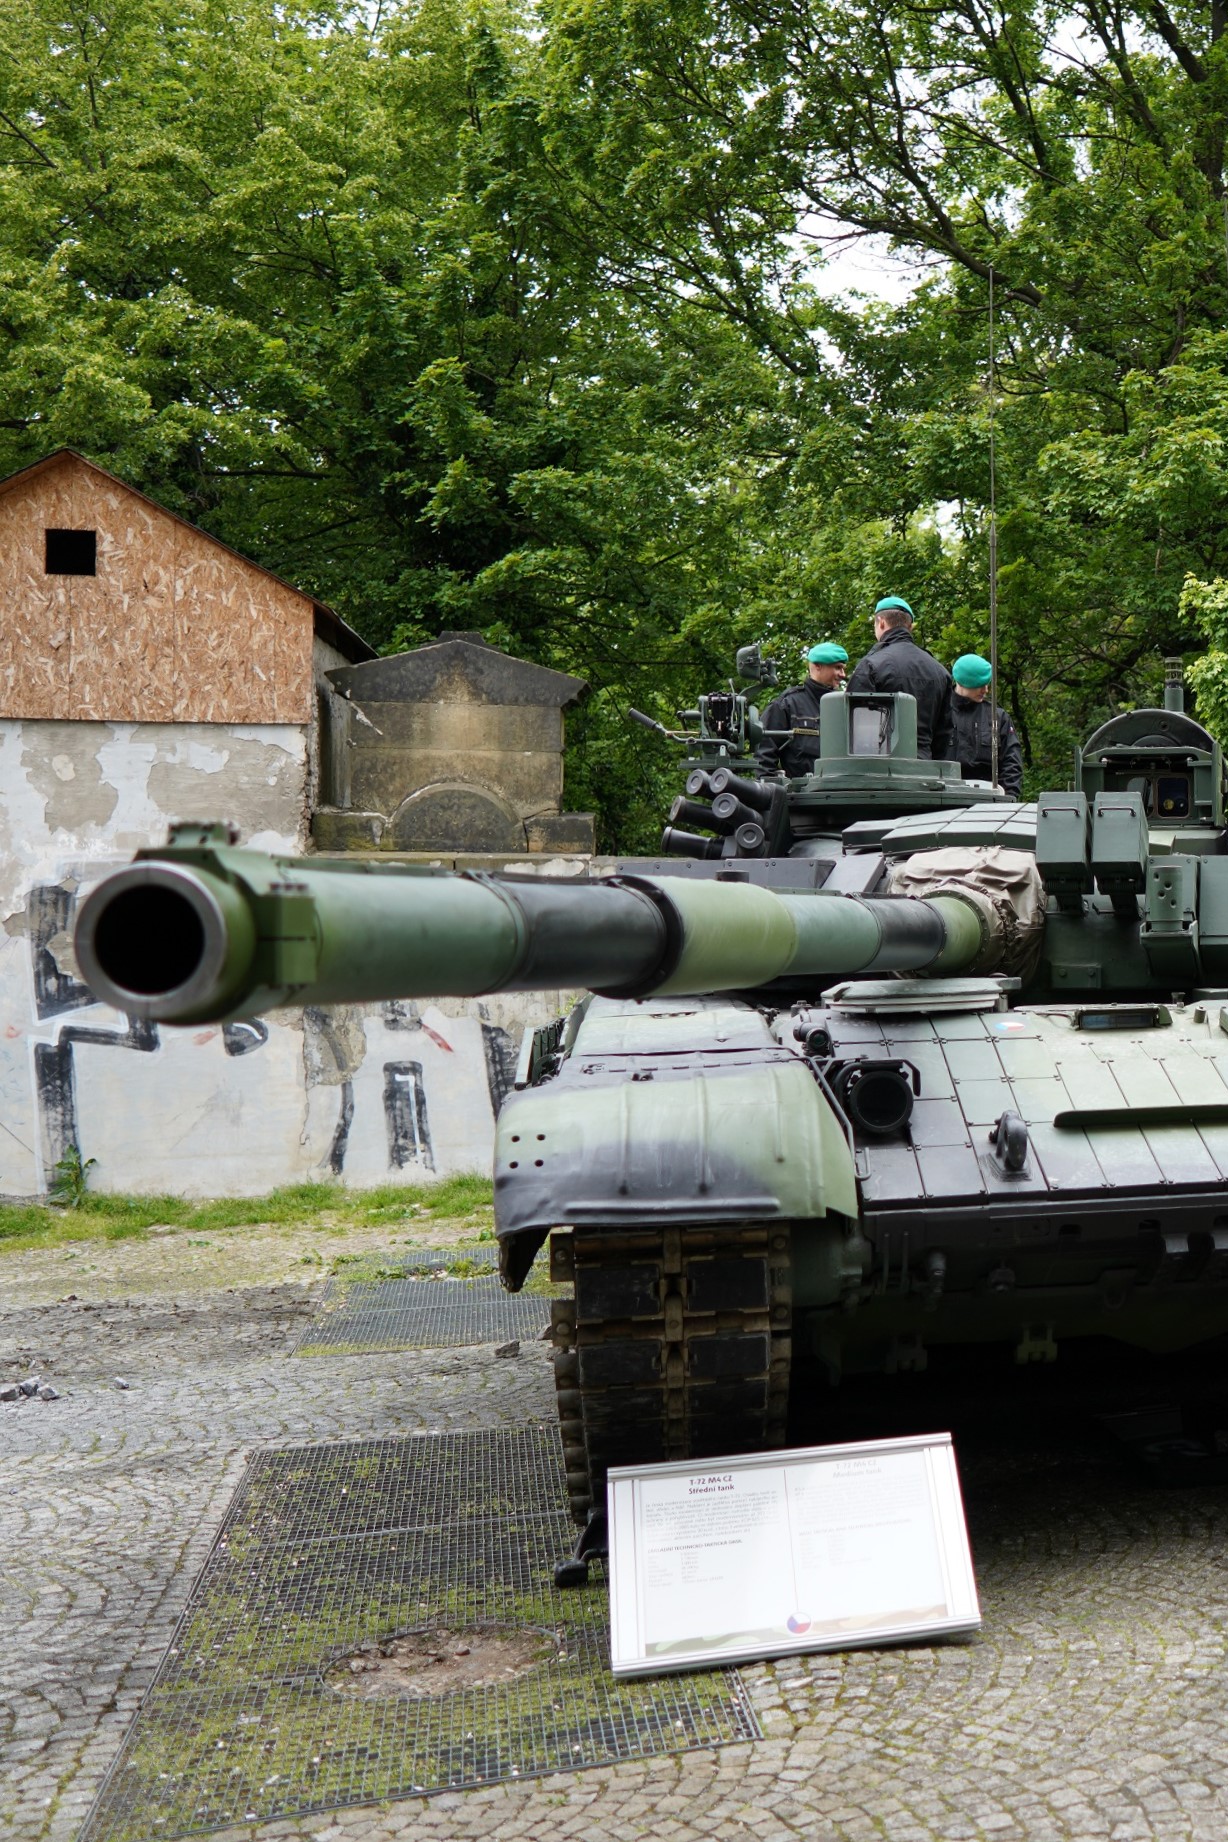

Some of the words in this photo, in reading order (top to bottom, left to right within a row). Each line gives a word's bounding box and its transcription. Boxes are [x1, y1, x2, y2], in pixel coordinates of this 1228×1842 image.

[689, 1478, 706, 1486] T-72
[707, 1476, 722, 1484] M4
[717, 1483, 735, 1492] tank
